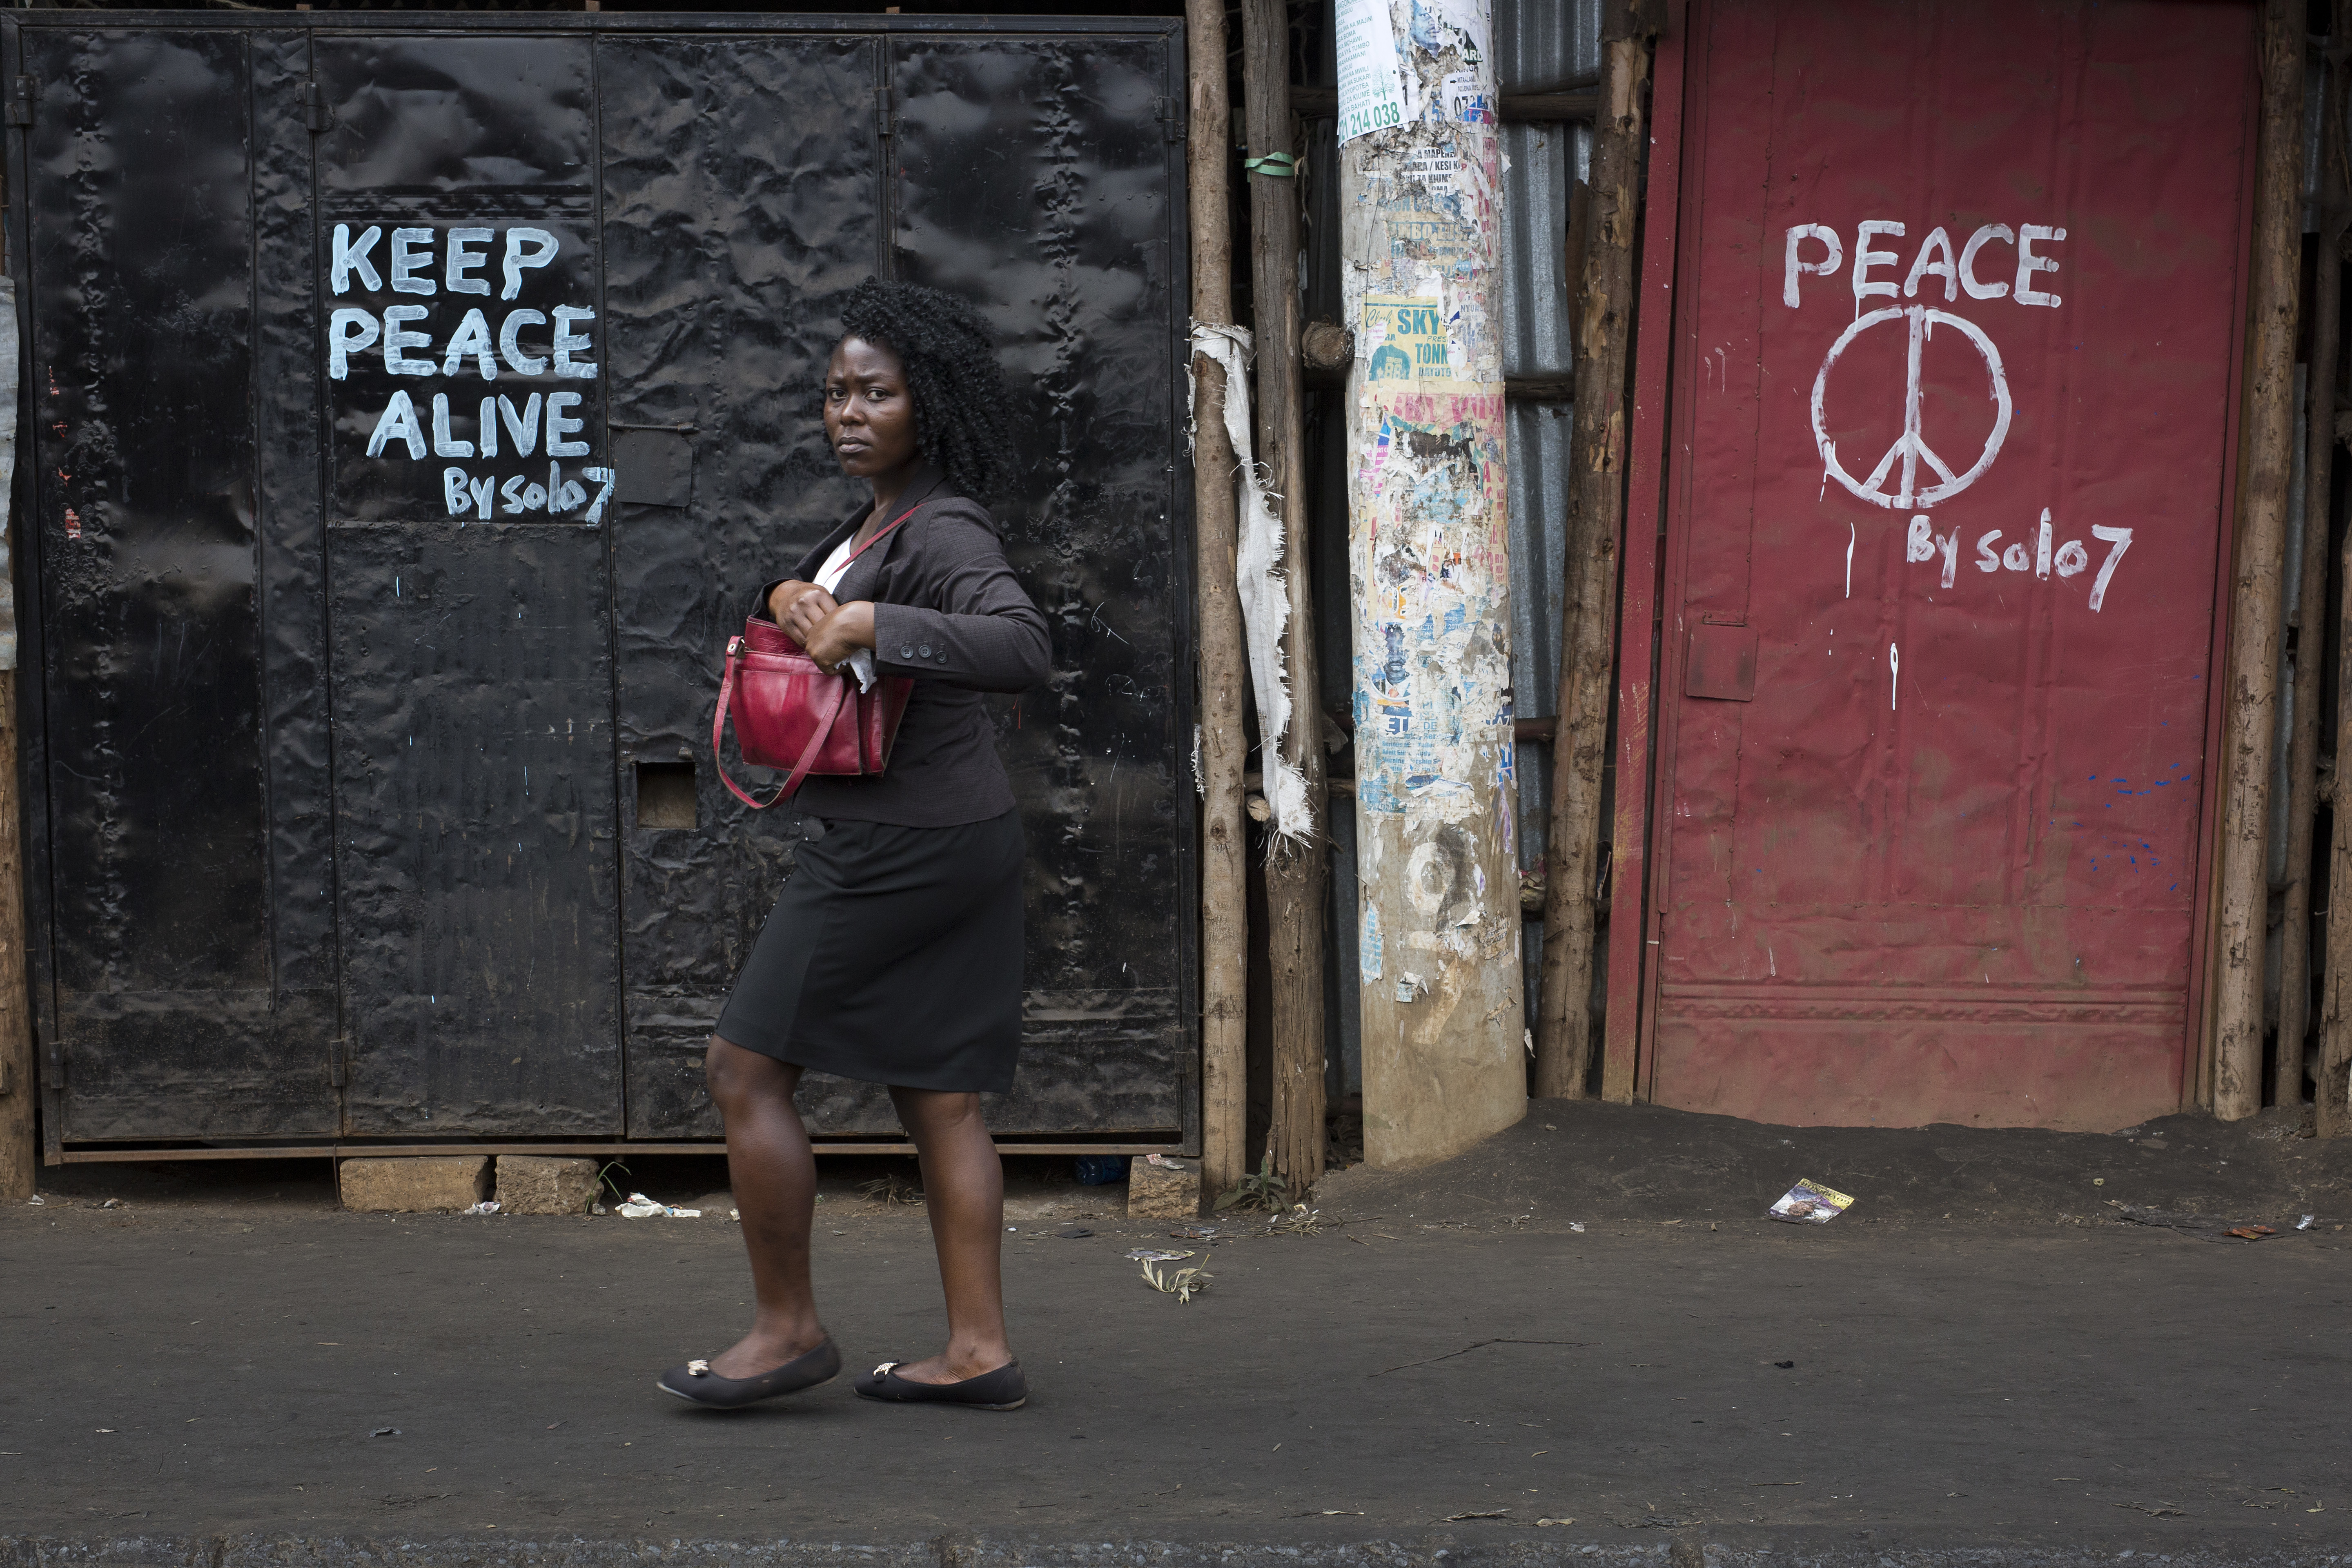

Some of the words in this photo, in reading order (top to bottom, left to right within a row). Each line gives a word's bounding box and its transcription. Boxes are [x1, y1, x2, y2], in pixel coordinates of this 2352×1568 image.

[1356, 16, 1373, 26] MAJINI
[1343, 30, 1356, 39] BOMA
[1344, 36, 1362, 46] MCHAWI
[1352, 41, 1370, 51] TUMBO
[1355, 66, 1369, 75] MWILI
[1353, 73, 1371, 84] SUKARI
[1353, 89, 1370, 99] KIUME
[1351, 99, 1370, 111] BAHATI
[1350, 109, 1371, 136] 214
[1373, 102, 1400, 127] 038
[1435, 160, 1452, 171] KESI
[332, 224, 559, 300] KEEP
[1784, 220, 2066, 308] PEACE
[1397, 309, 1440, 334] SKY
[330, 304, 598, 380] PEACE
[366, 390, 590, 460] ALIVE
[443, 467, 494, 519] By
[1907, 515, 1960, 588] By
